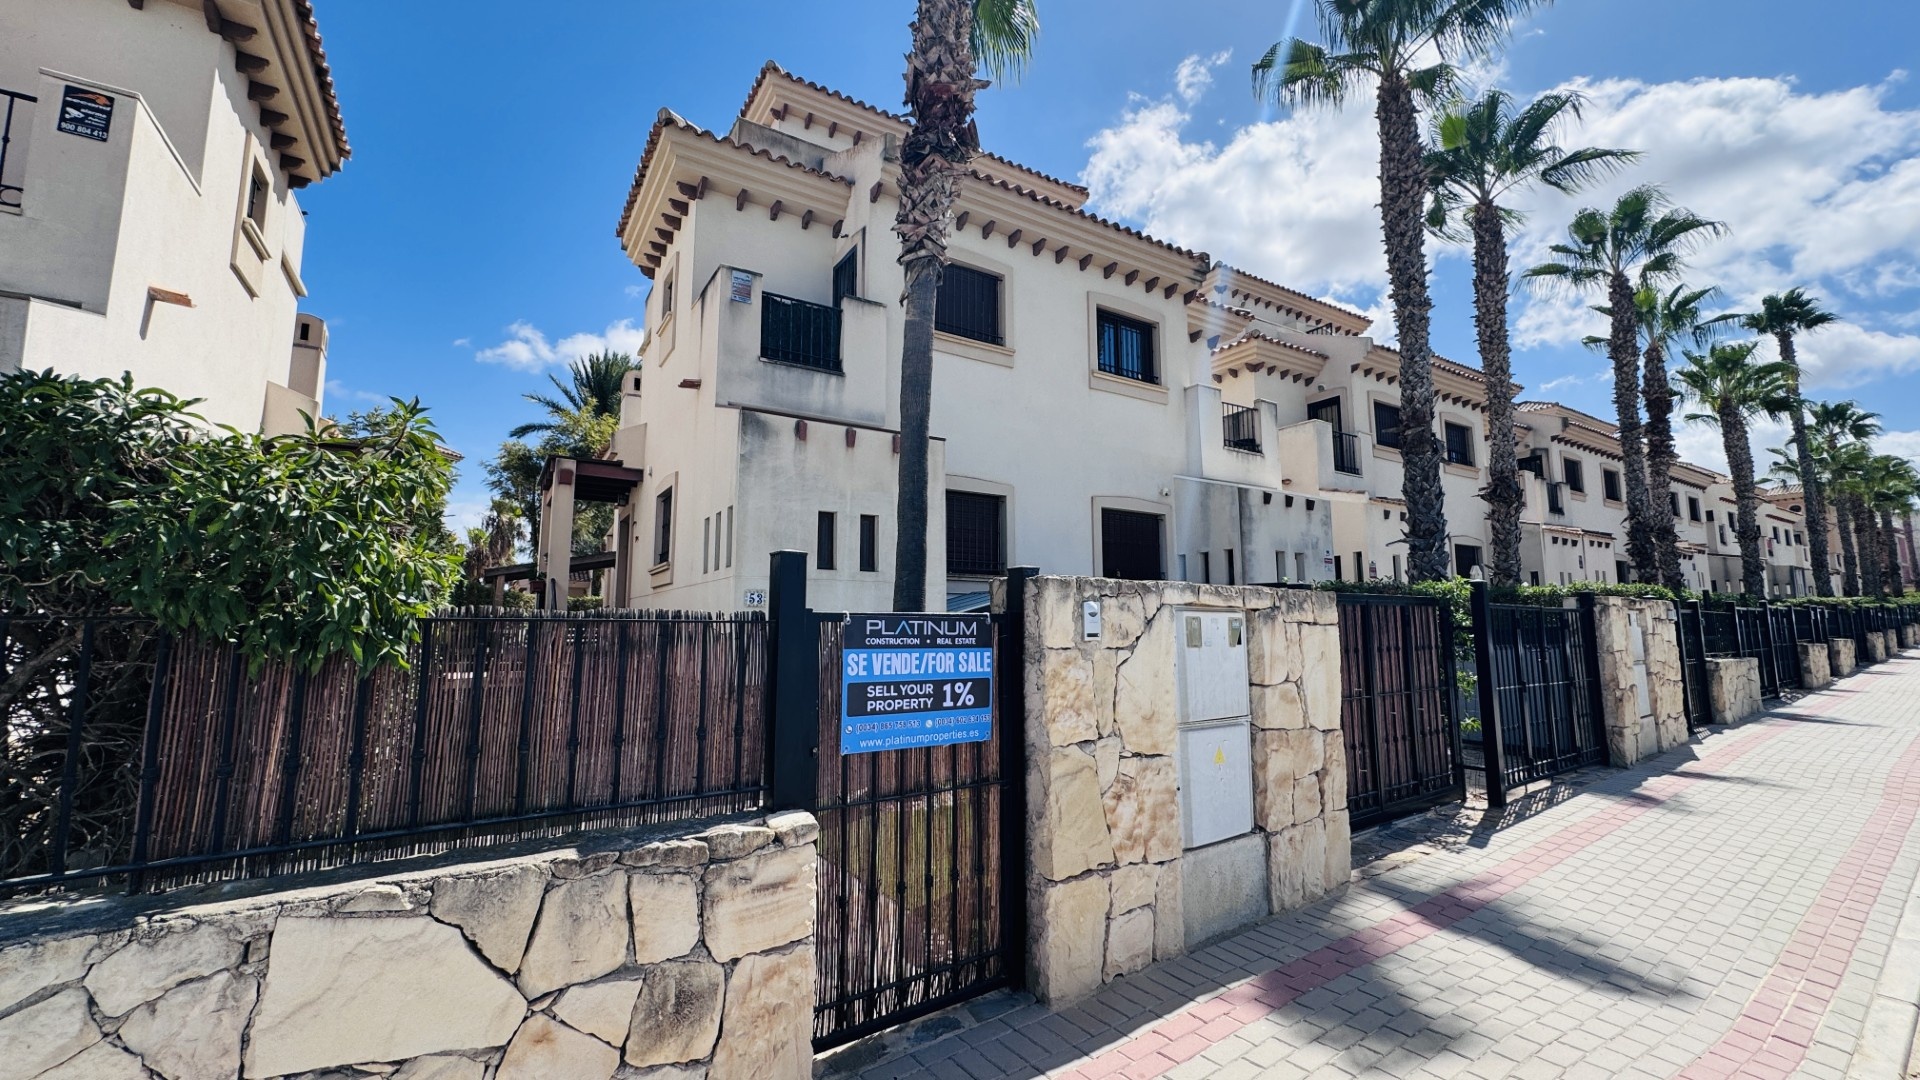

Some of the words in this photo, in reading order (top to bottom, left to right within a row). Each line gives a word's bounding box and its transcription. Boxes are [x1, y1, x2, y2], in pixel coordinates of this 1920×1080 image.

[60, 121, 76, 131] 900
[76, 125, 92, 135] 804
[92, 129, 108, 139] 413
[748, 592, 763, 605] 53
[865, 619, 977, 636] PLATINUM
[865, 637, 920, 646] CONSTRUCTION
[936, 637, 952, 645] REAL
[954, 637, 977, 645] ESTATE
[847, 652, 868, 676] SE
[871, 651, 955, 676] VENDE/FOR
[958, 651, 991, 673] SALE
[866, 685, 898, 698] SELL
[899, 683, 934, 696] YOUR
[942, 681, 975, 708] 1%
[866, 697, 934, 712] PROPERTY
[859, 729, 980, 748] www.platinumproperties.es
